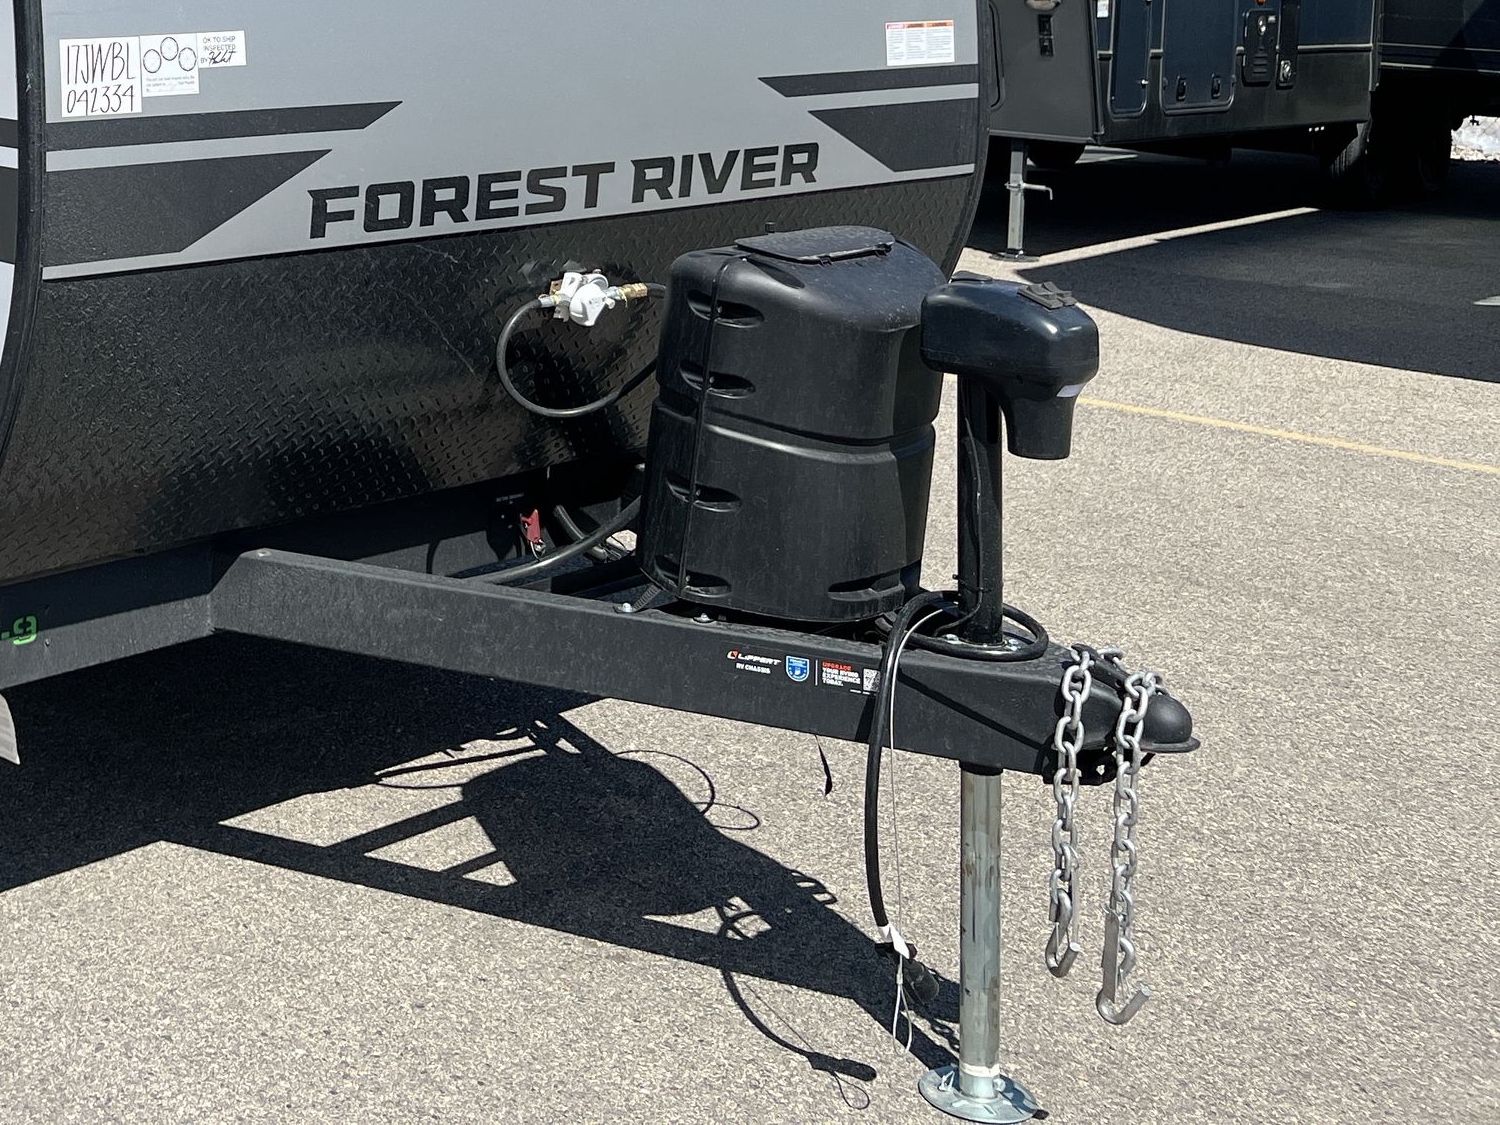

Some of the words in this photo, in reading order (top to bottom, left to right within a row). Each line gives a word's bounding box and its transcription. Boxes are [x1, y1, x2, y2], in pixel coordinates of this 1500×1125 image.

[67, 84, 134, 115] 042334
[307, 161, 616, 239] FOREST
[630, 141, 820, 204] RIVER
